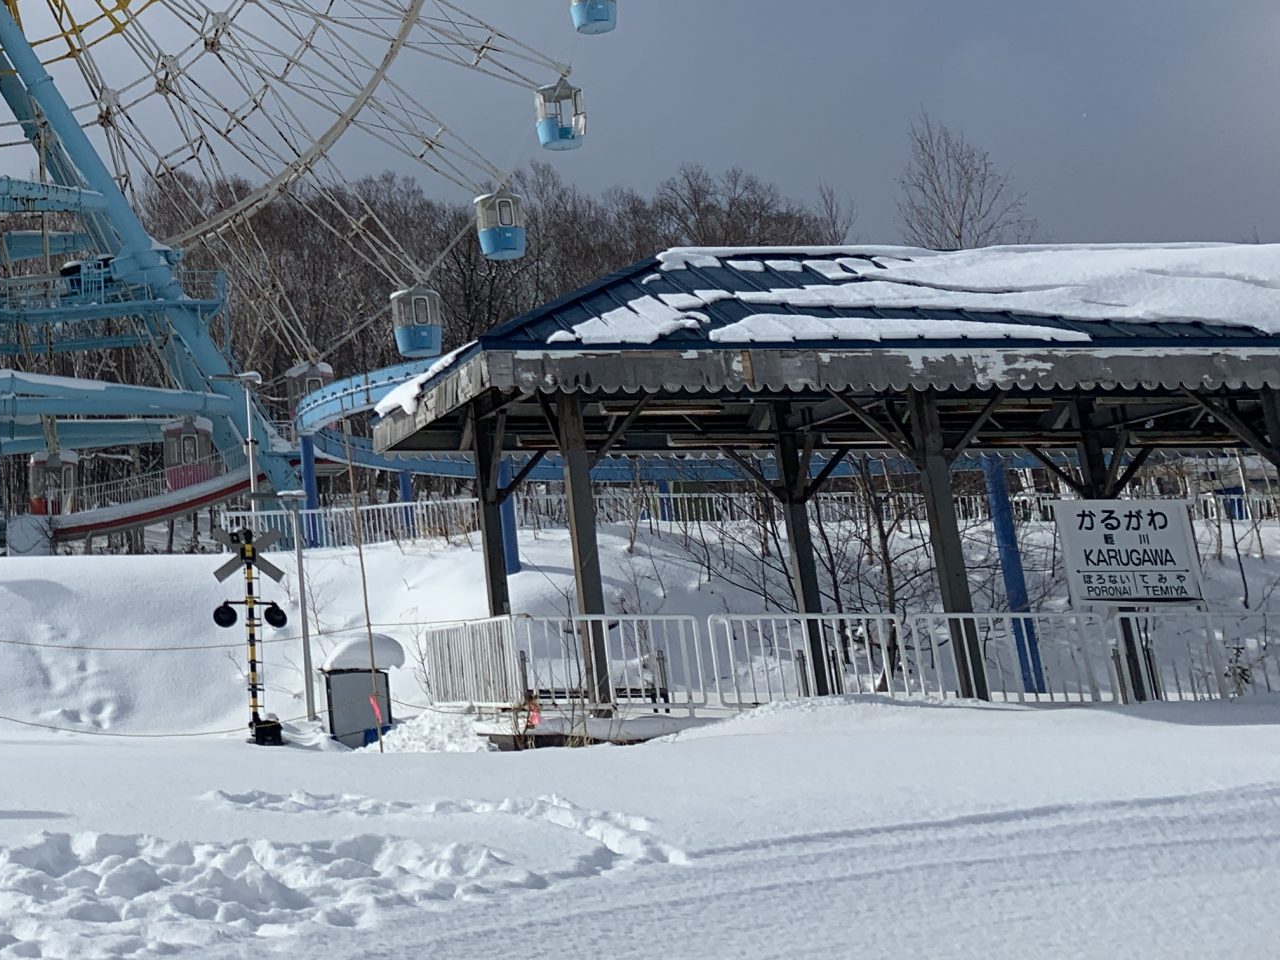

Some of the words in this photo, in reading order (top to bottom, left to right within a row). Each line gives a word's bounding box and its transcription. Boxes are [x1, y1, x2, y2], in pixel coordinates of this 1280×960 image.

[1076, 509, 1168, 531] かるがわ
[1083, 548, 1177, 567] KARUGAWA
[1139, 573, 1186, 585] てみや
[1087, 586, 1132, 596] PORONAI
[1144, 585, 1189, 596] TEMIYA
